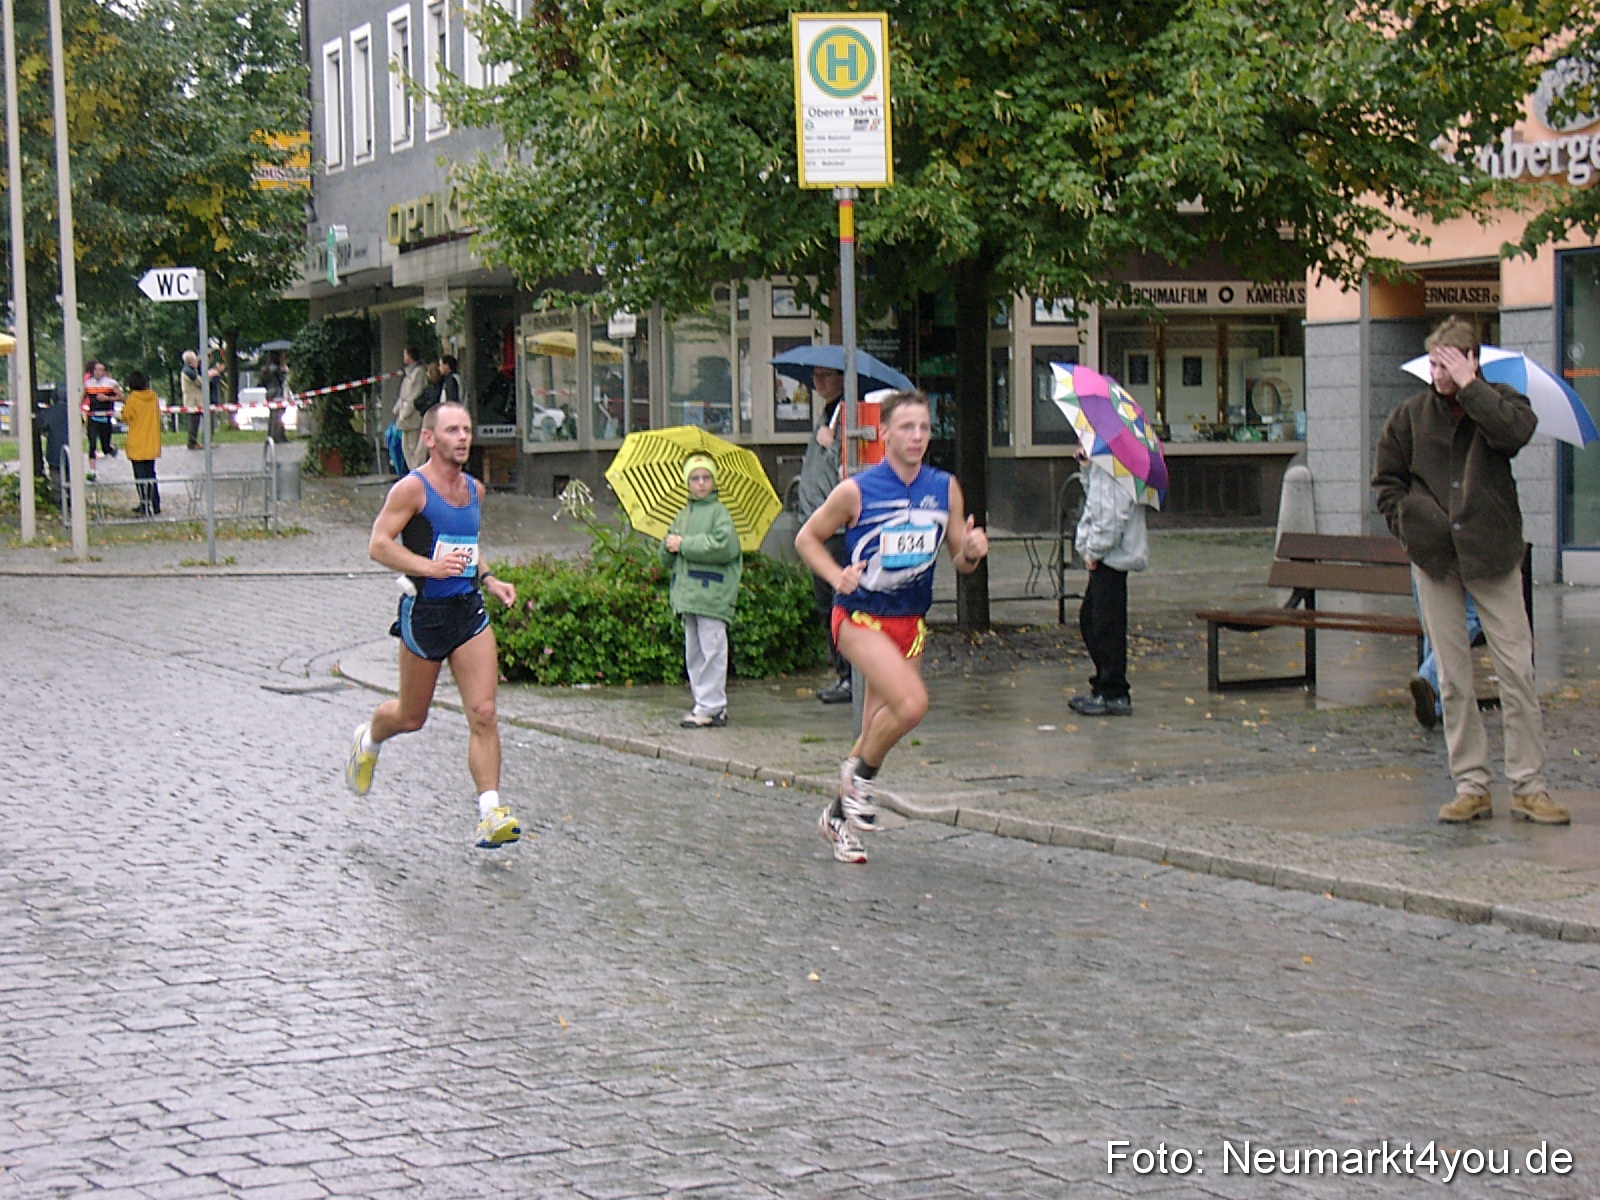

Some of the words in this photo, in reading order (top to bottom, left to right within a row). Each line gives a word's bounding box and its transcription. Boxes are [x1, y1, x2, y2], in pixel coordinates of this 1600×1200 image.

[826, 43, 858, 82] H
[807, 107, 844, 118] Oberer
[849, 107, 879, 117] Markt
[156, 273, 190, 297] WC
[1133, 287, 1208, 304] SCHMALFILM
[897, 533, 925, 552] 634
